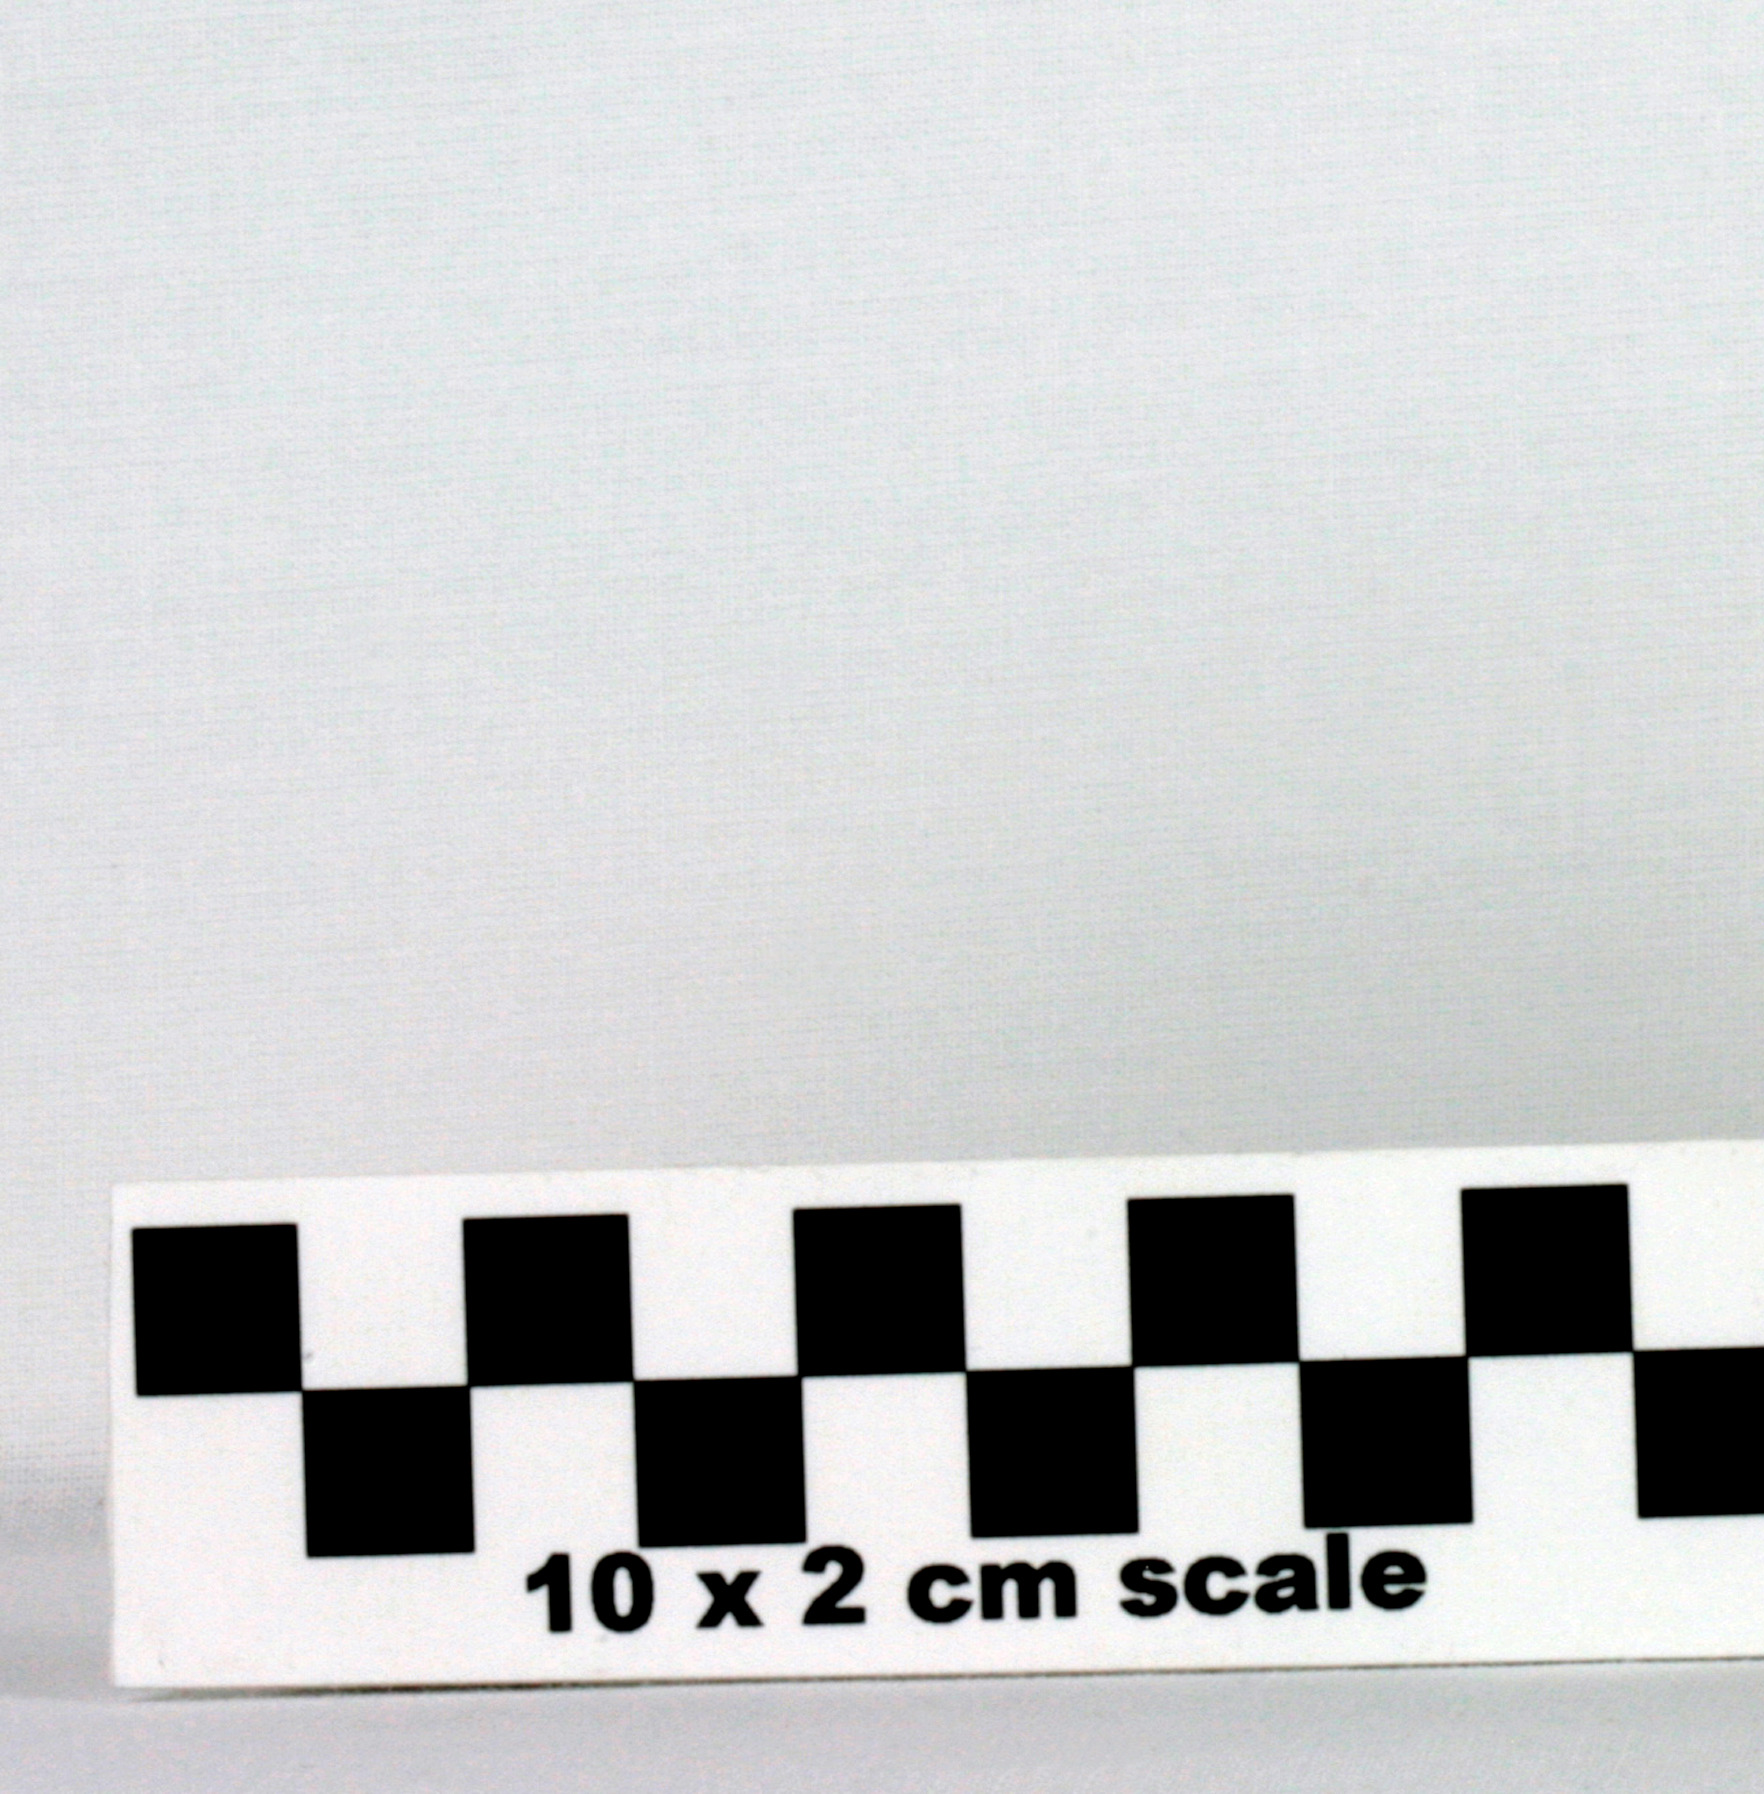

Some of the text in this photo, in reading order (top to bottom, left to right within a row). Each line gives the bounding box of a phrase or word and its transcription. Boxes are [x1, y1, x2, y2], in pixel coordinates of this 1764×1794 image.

[525, 1532, 1429, 1633] 10 x 2 cm scale
